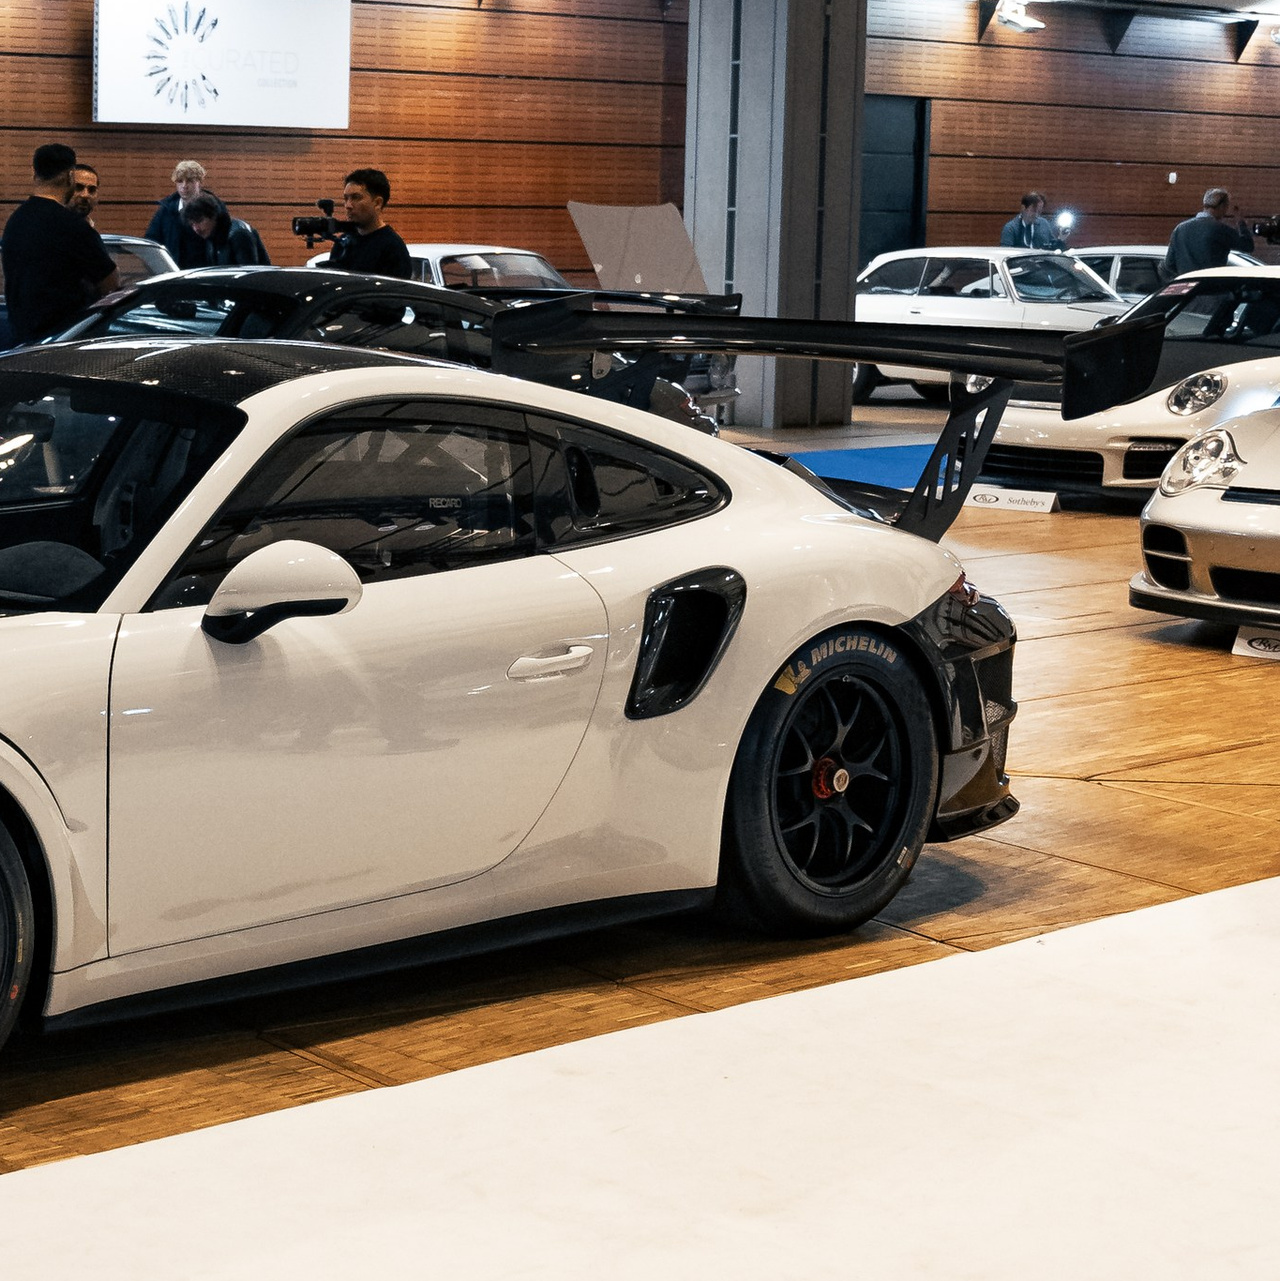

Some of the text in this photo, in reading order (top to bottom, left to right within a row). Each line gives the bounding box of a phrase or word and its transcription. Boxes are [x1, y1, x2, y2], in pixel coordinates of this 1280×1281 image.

[191, 48, 300, 75] CURATED
[429, 497, 462, 508] RECARO
[1006, 497, 1046, 508] Sotheby's
[810, 635, 898, 666] MICHELIN
